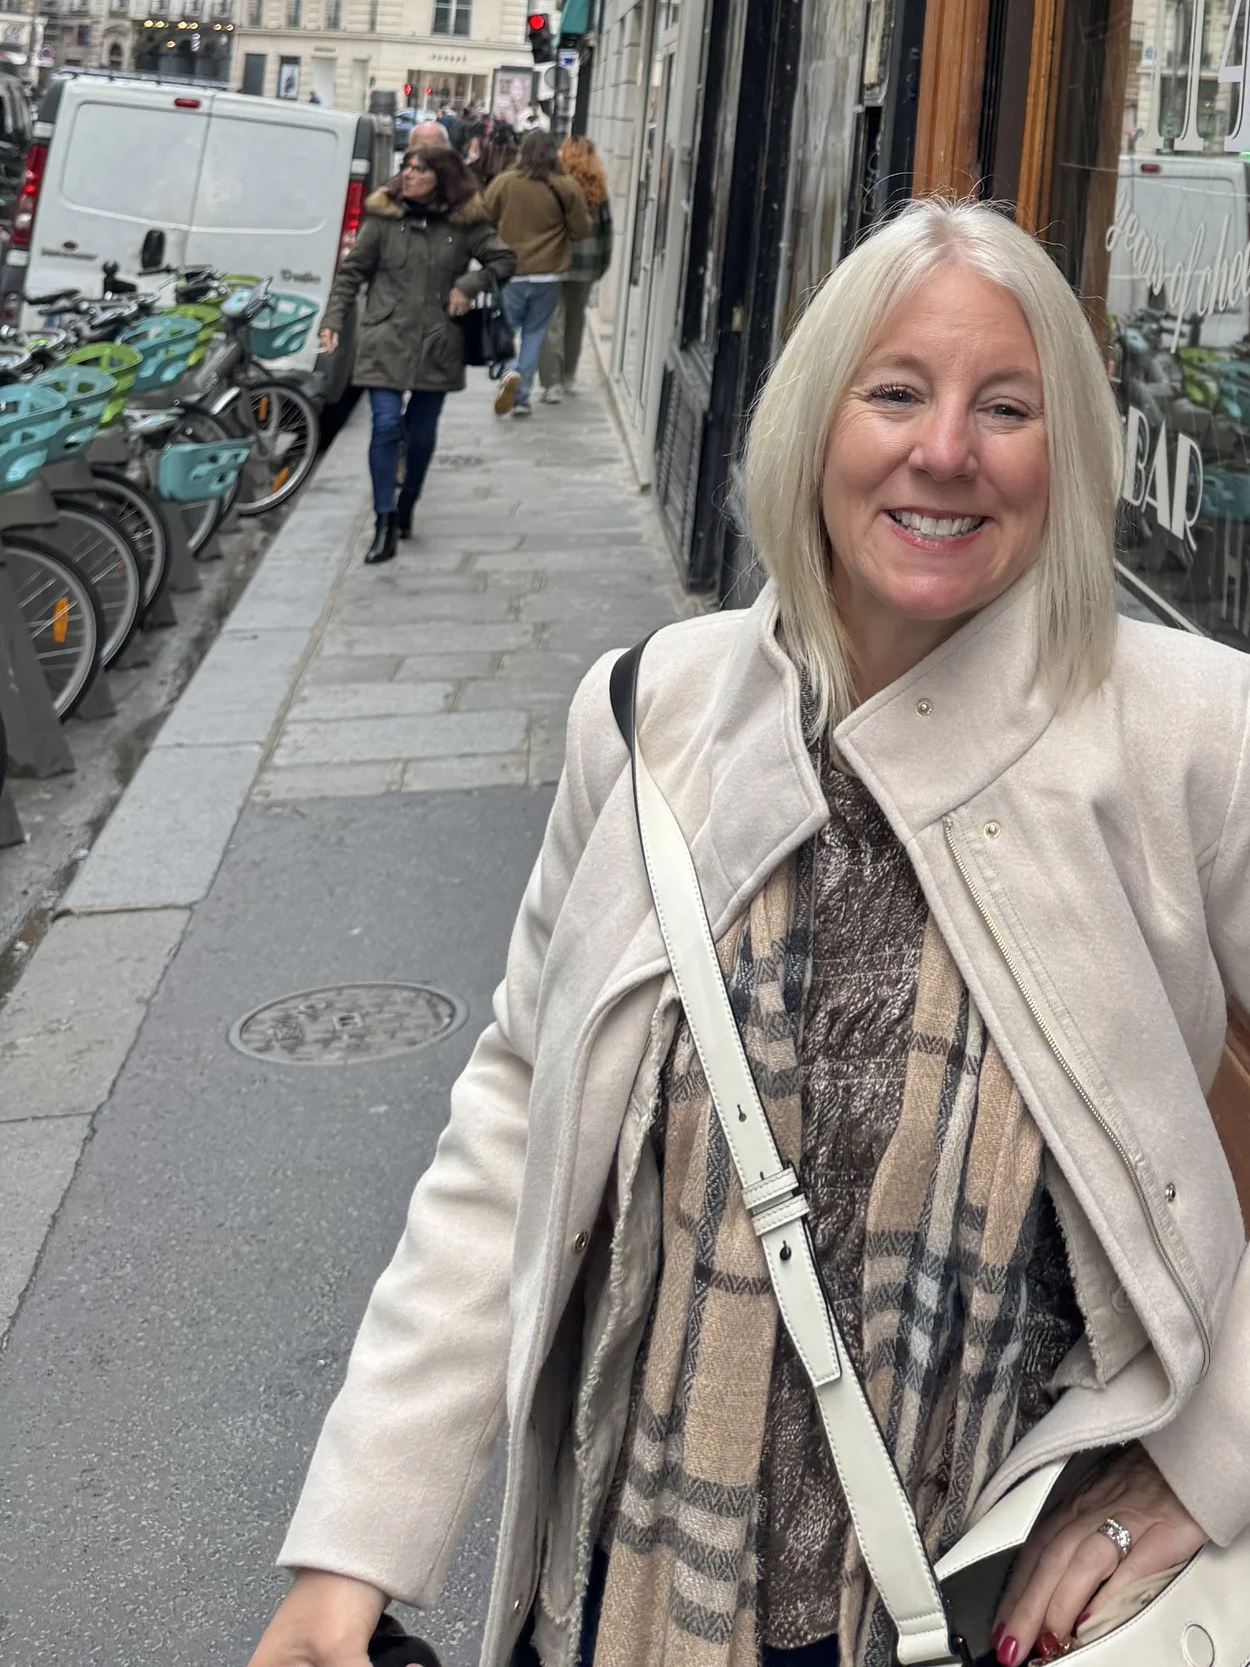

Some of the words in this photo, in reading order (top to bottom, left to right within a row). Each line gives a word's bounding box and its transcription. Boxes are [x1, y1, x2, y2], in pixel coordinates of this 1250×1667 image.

[1105, 189, 1167, 296] years
[1170, 221, 1206, 355] of
[1121, 405, 1204, 552] BAR
